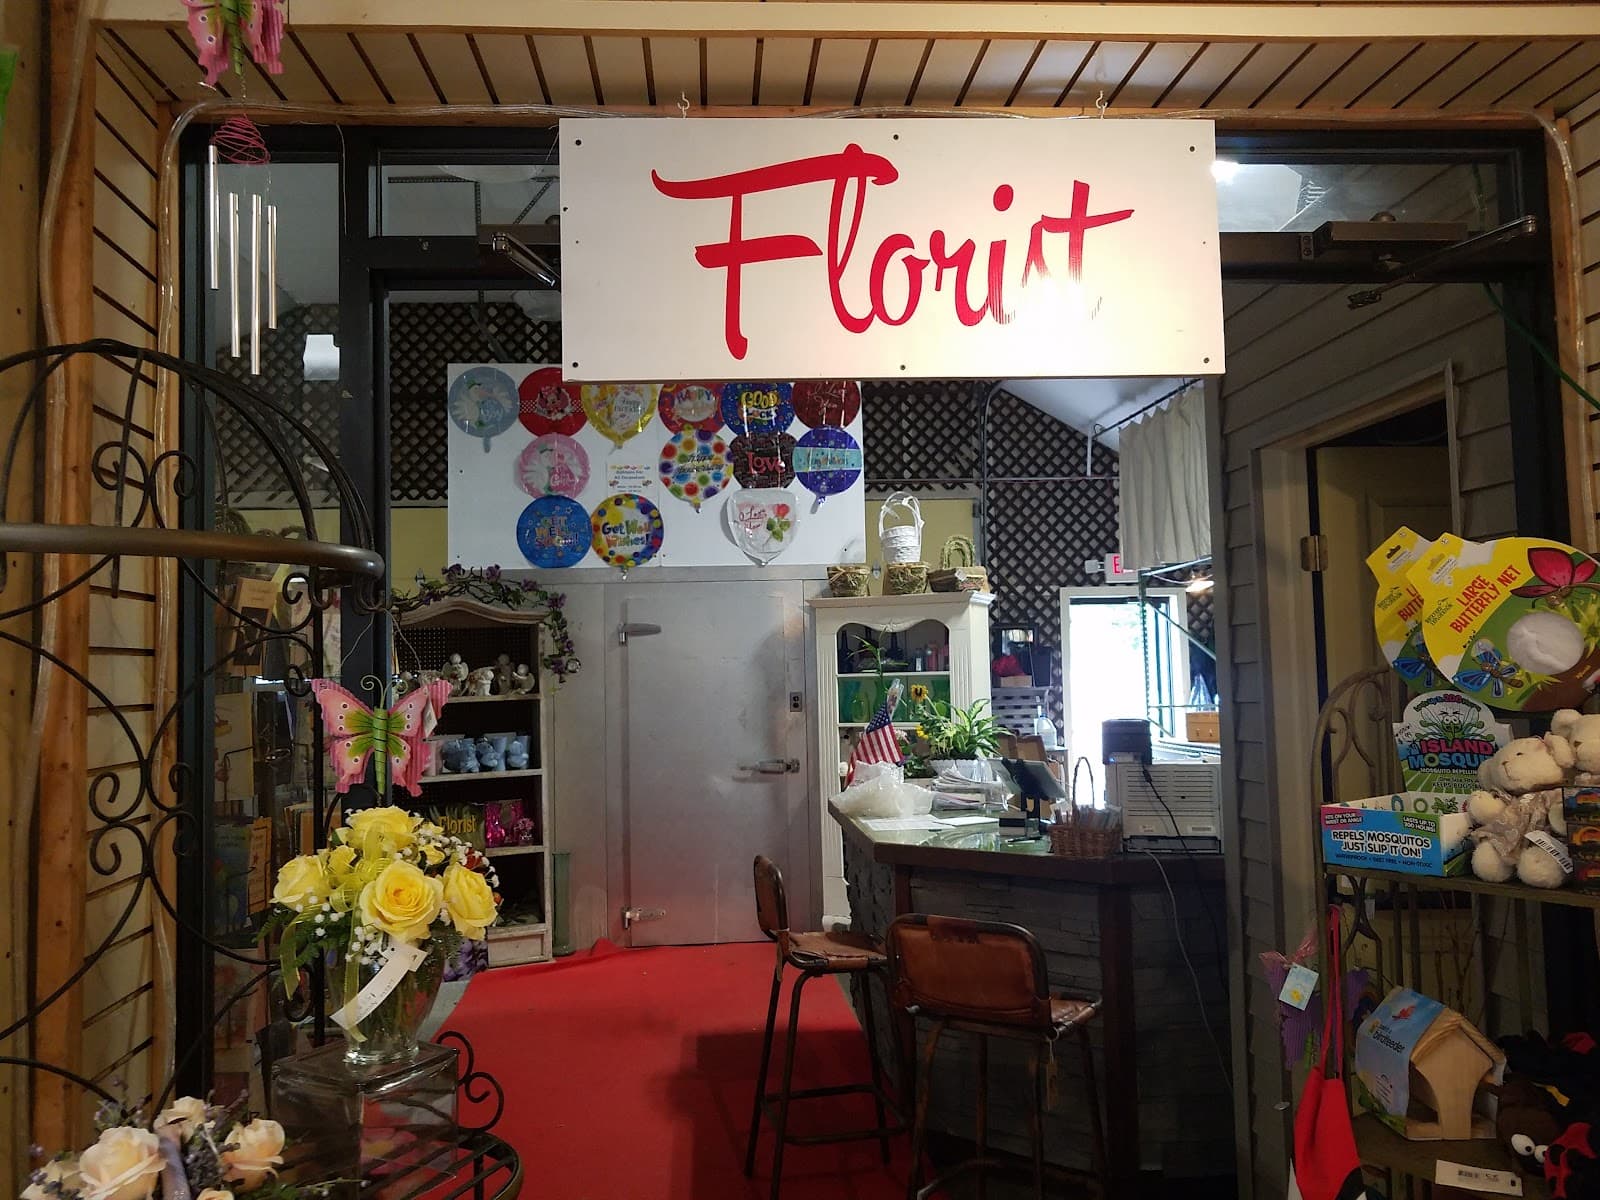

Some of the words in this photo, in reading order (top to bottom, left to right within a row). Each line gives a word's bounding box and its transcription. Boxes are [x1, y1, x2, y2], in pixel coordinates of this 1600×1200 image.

[651, 143, 1135, 360] Florist
[741, 390, 780, 409] GOOD
[602, 521, 625, 535] Get
[1449, 584, 1502, 634] BUTTERFLY
[1498, 564, 1522, 588] NET
[1456, 575, 1491, 606] LARGE
[1420, 739, 1495, 755] ISLAND
[1407, 753, 1489, 770] MOSQU
[439, 815, 476, 834] Florist
[1332, 830, 1364, 841] REPELS
[1367, 831, 1431, 848] MOSQUITOS
[1342, 842, 1365, 852] JUST
[1367, 842, 1387, 854] SLIP
[1389, 845, 1399, 856] IT
[1400, 846, 1421, 858] ON!
